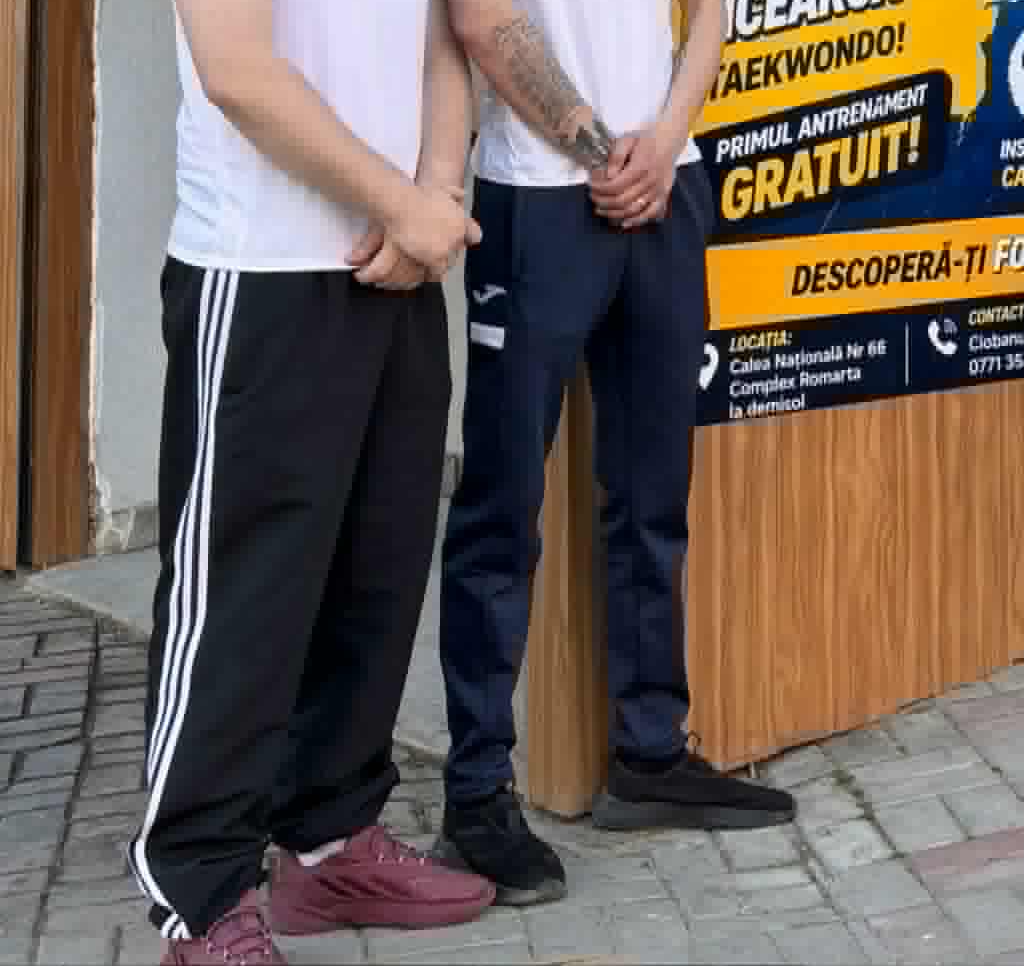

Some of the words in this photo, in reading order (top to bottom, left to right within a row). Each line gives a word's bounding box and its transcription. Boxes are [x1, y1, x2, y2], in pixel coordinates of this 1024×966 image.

[715, 122, 793, 163] PRIMUL
[798, 83, 929, 139] ANTRENAMENT
[720, 116, 922, 221] GRATUIT!
[846, 343, 864, 359] Nr
[729, 373, 796, 397] Complex
